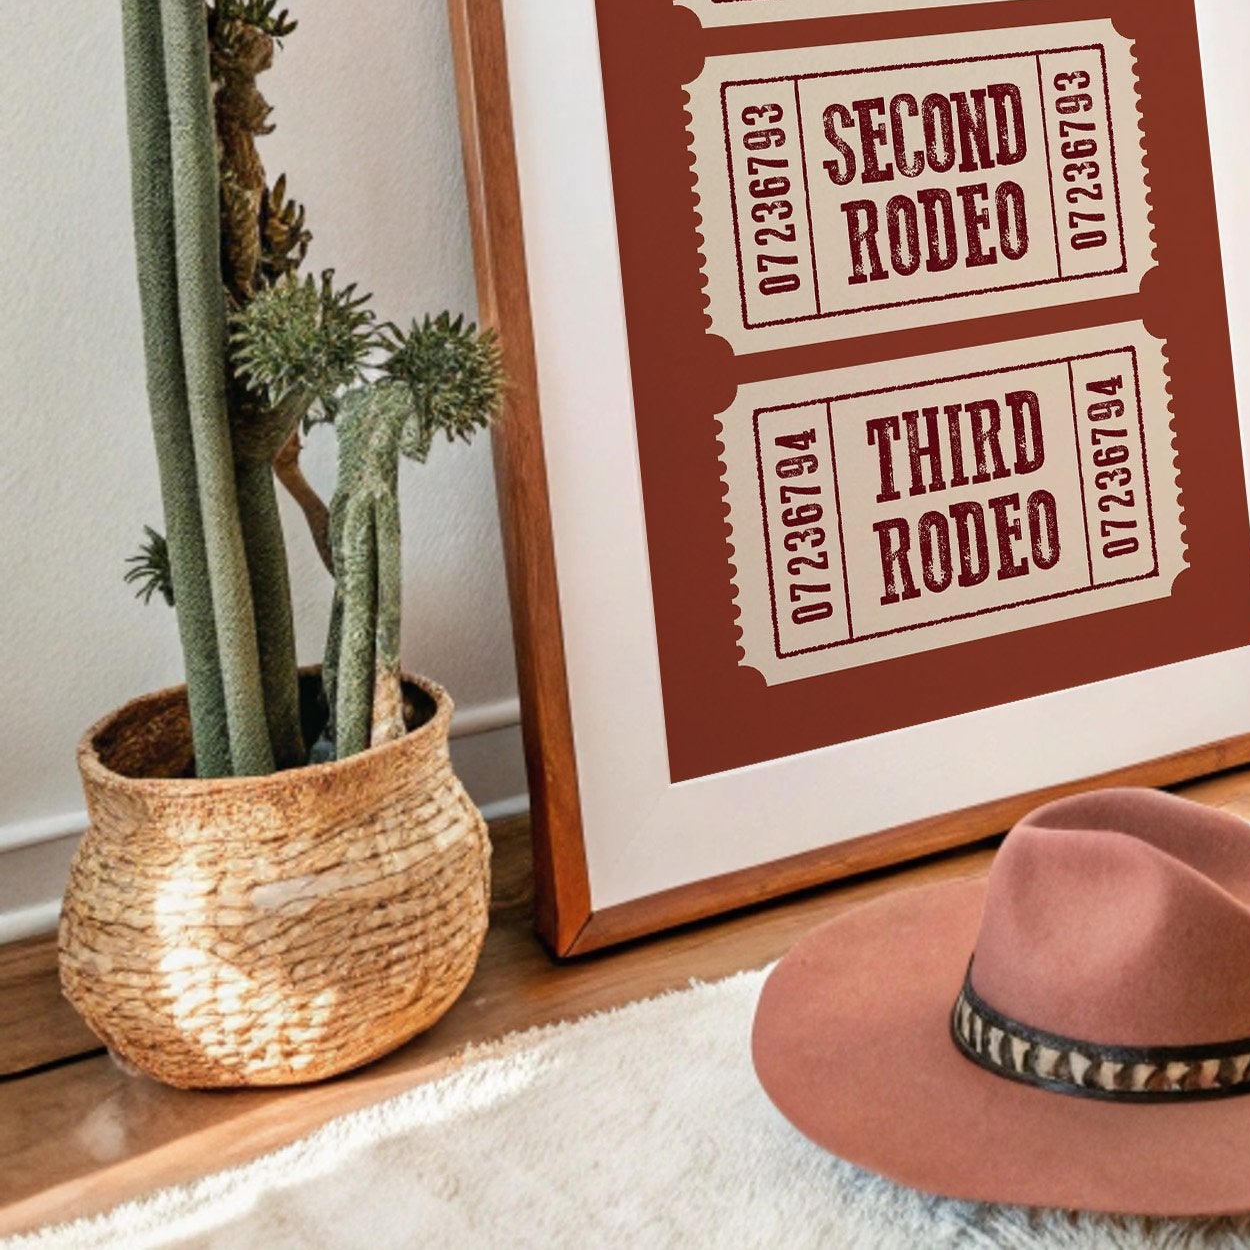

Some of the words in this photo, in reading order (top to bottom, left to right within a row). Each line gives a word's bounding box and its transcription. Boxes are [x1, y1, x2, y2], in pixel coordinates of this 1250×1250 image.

[741, 103, 800, 296] 07236793
[822, 83, 1027, 186] SECOND
[1054, 70, 1107, 250] 07236793
[841, 180, 1029, 285] RODEO
[866, 390, 1045, 503] THIRD
[1086, 375, 1140, 558] 07236794
[775, 428, 833, 625] 07236794
[873, 489, 1061, 605] RODEO
